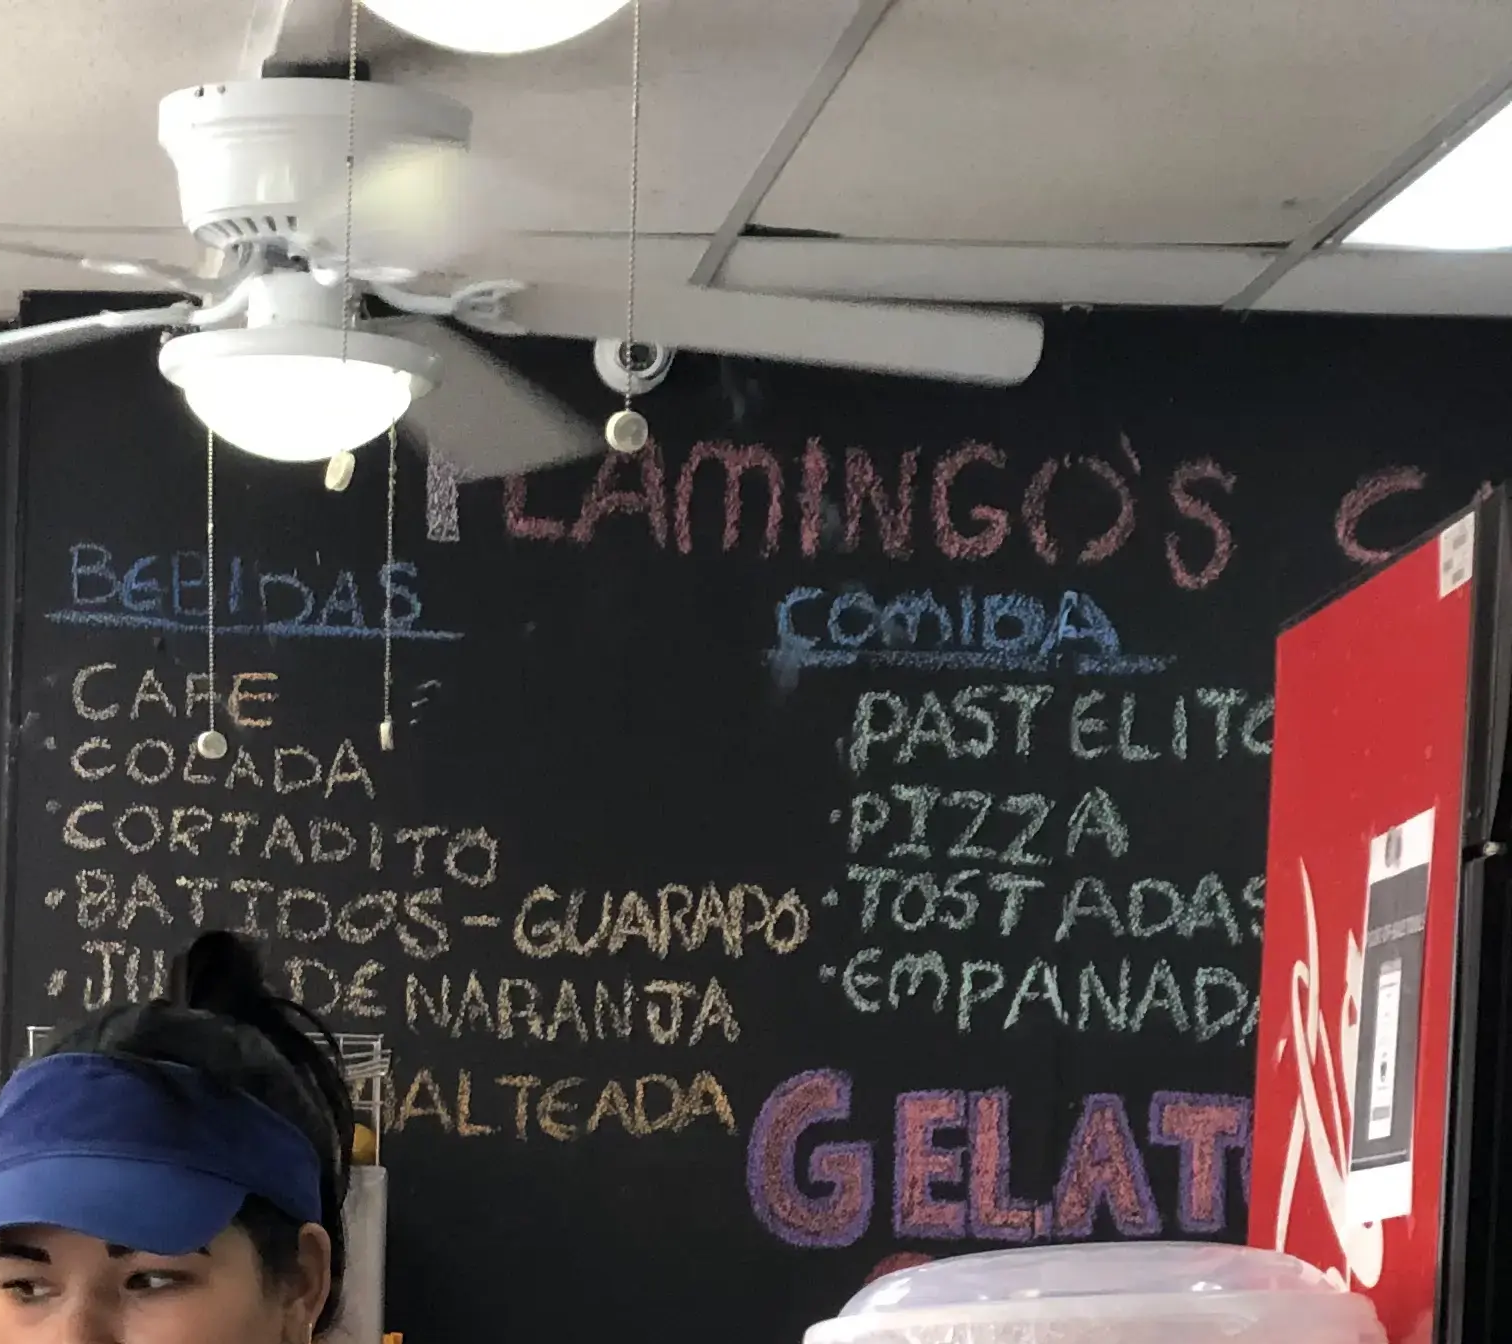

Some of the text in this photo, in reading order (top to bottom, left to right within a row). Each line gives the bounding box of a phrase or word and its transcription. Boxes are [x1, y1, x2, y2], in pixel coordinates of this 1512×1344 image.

[69, 541, 423, 630] BEBIDAS
[774, 584, 1122, 660] COMIDA
[72, 662, 279, 728] CAFE
[70, 736, 376, 800] COLADA
[62, 801, 500, 888] CORTADITO
[848, 785, 1130, 867] PIZZA
[284, 955, 386, 1018] DE
[405, 970, 741, 1046] NARANJA
[841, 948, 1260, 1046] EMPANAD
[746, 1067, 1254, 1248] GELAT
